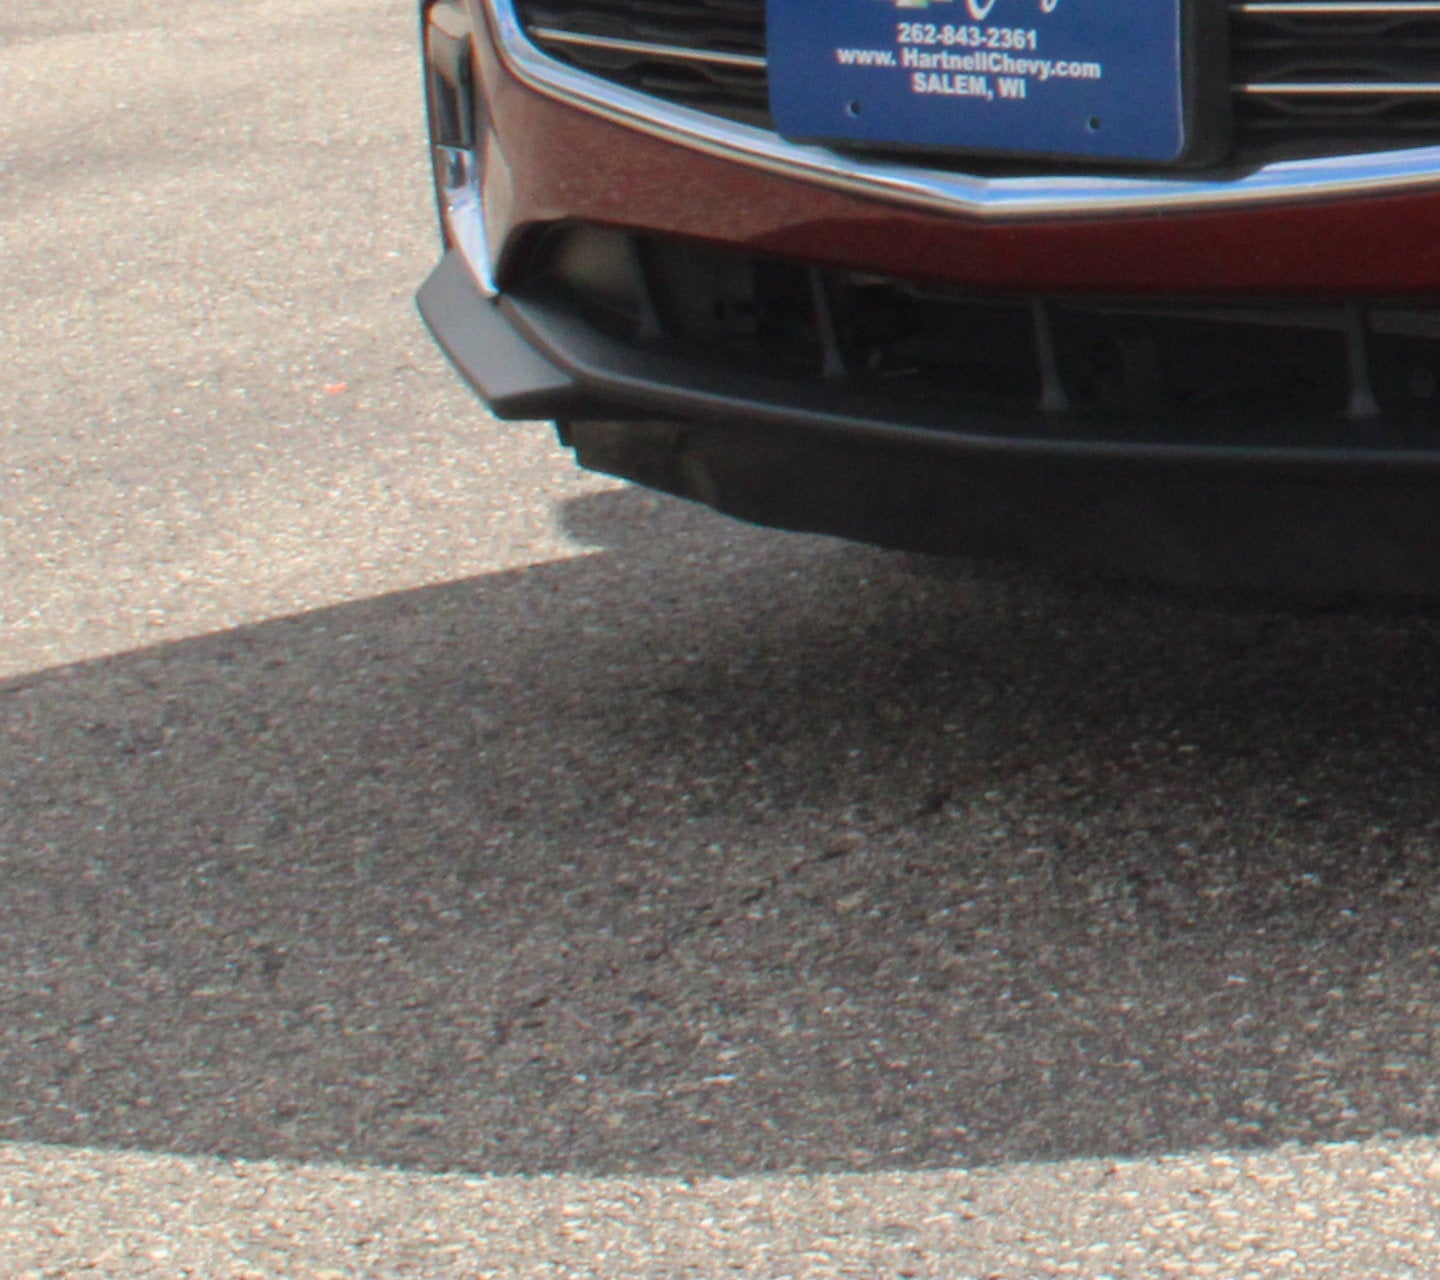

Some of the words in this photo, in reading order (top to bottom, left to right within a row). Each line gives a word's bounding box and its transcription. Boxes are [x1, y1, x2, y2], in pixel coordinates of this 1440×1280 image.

[896, 22, 1037, 51] 262-843-2361
[836, 48, 897, 67] www.
[902, 47, 1101, 82] HartnellChevy.com
[911, 72, 994, 101] SALEM,
[998, 77, 1026, 98] WI
